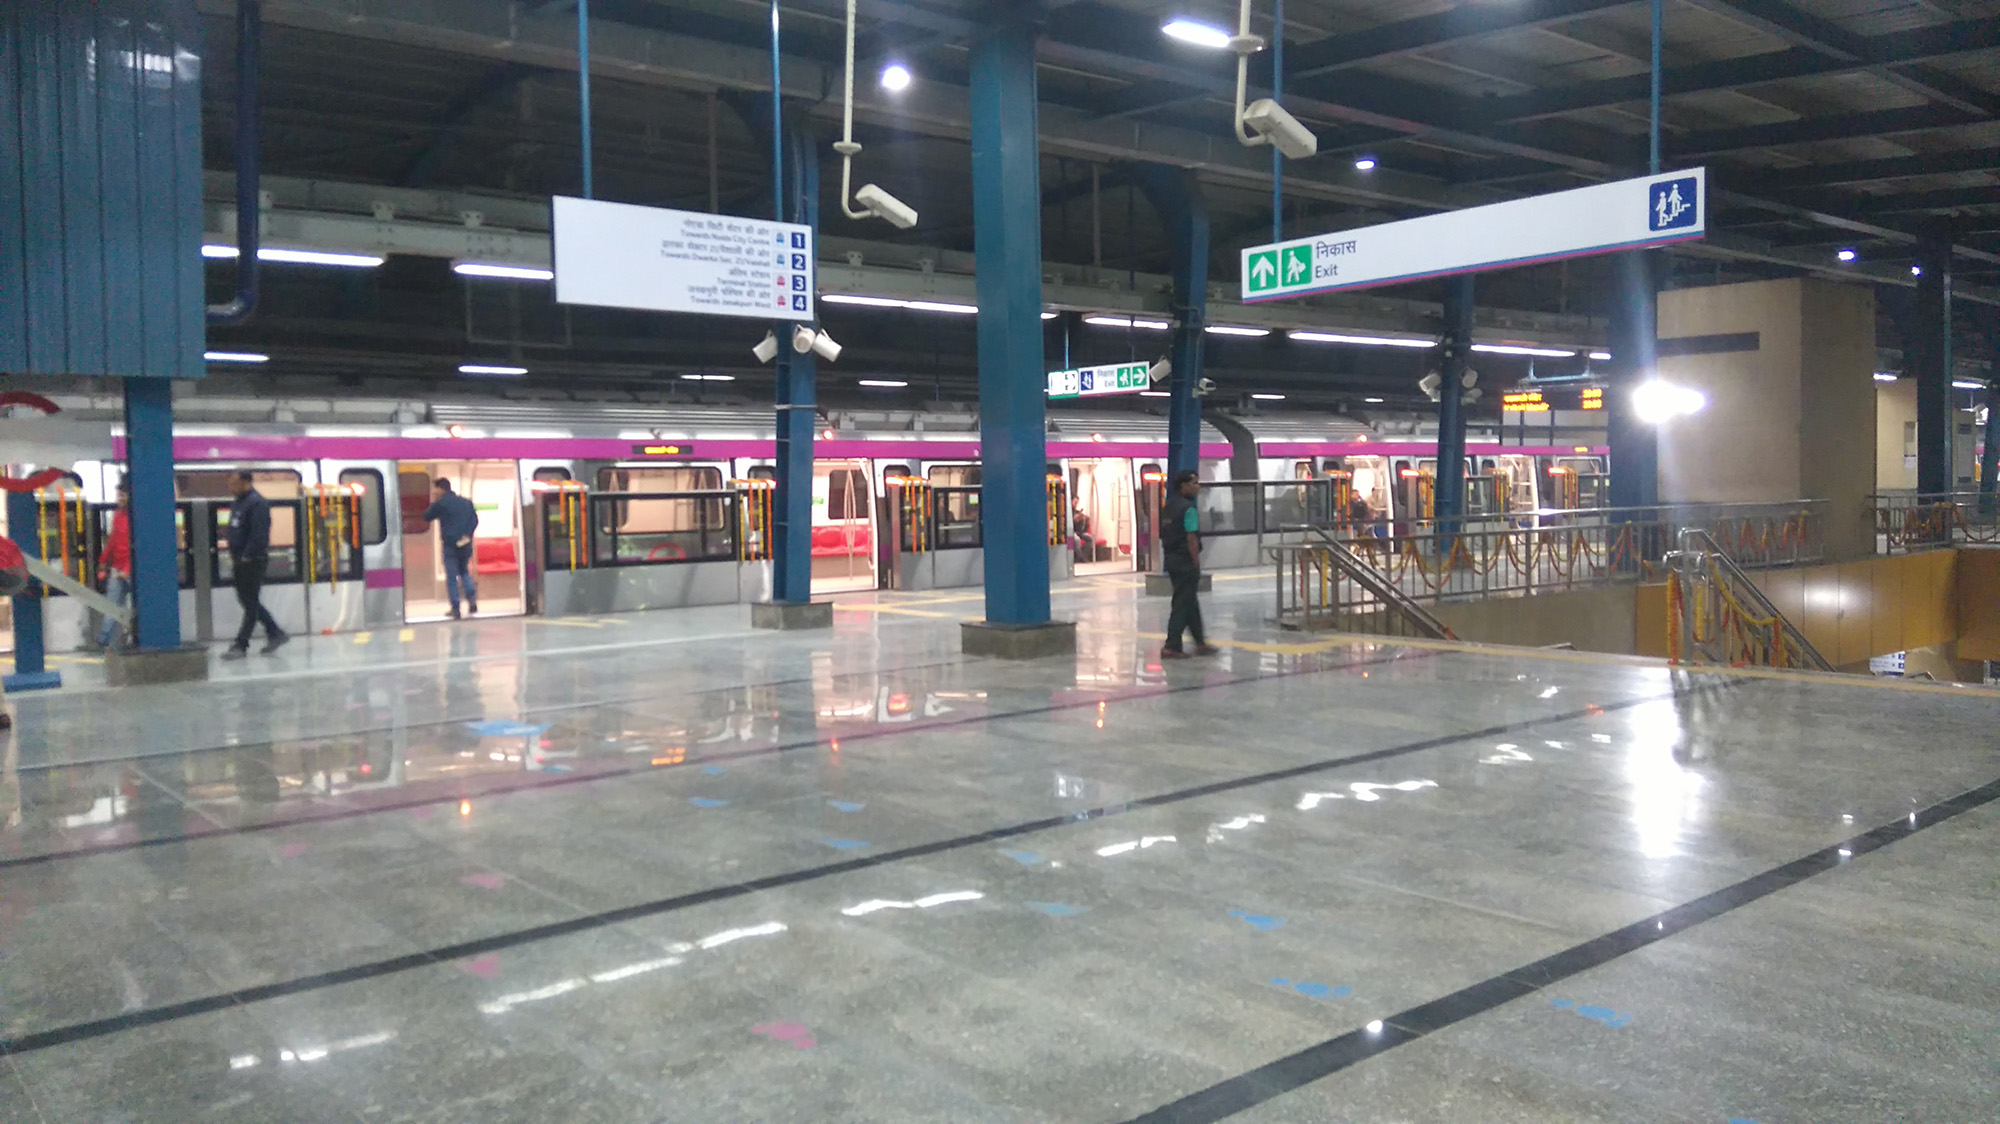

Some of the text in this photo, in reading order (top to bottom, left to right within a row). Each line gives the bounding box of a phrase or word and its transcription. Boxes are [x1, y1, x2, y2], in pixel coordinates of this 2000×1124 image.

[681, 229, 711, 239] Towards
[795, 234, 802, 248] 1
[661, 249, 691, 259] Towards
[1316, 240, 1357, 259] निकास
[794, 255, 804, 269] 2
[1315, 264, 1338, 278] Exit
[716, 276, 746, 286] Terminal
[795, 276, 804, 290] 3
[690, 295, 720, 305] Towards
[794, 296, 805, 310] 4
[1104, 380, 1115, 388] Exit
